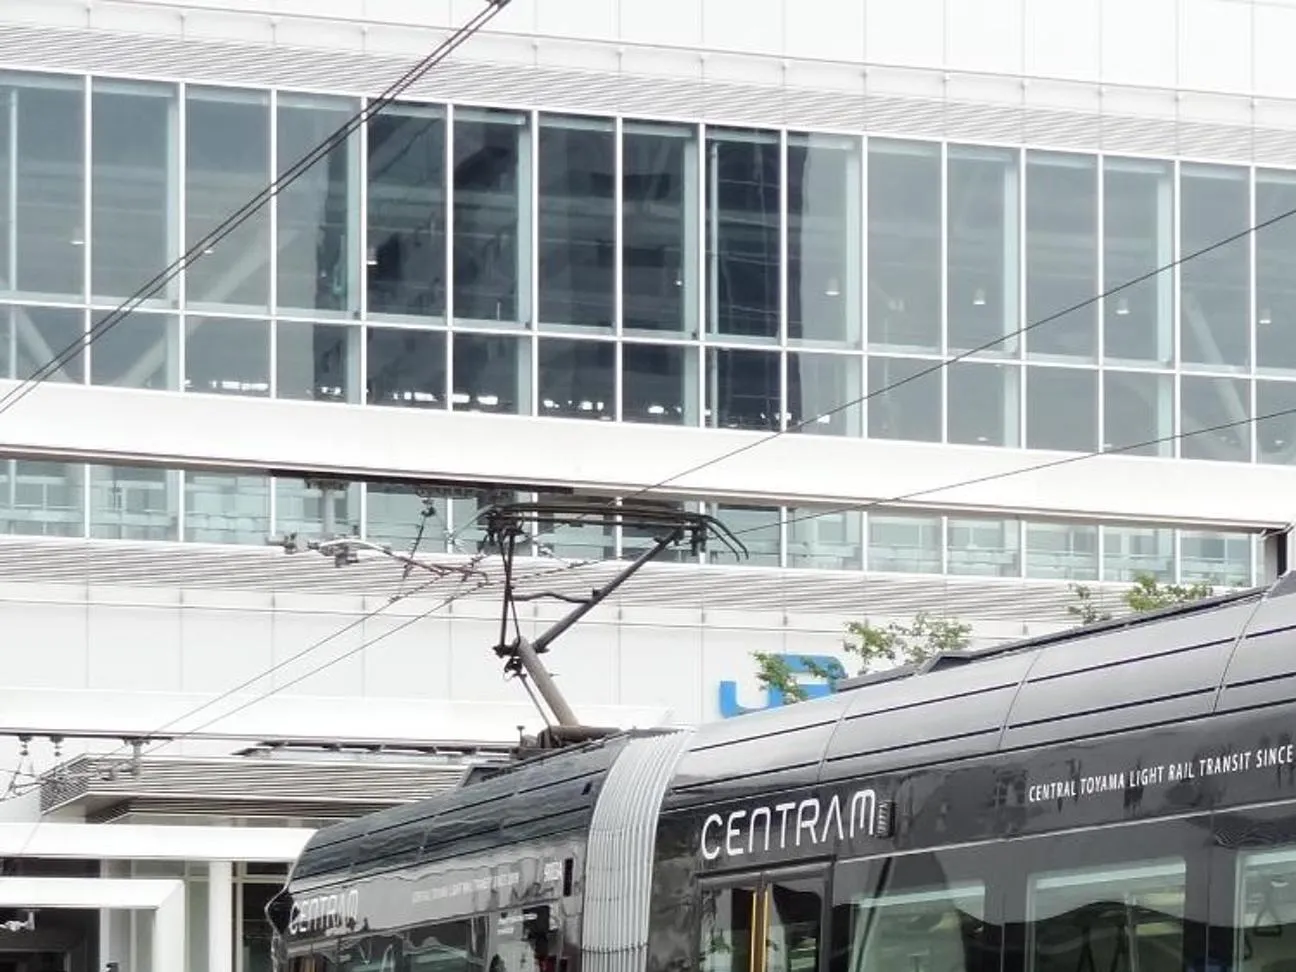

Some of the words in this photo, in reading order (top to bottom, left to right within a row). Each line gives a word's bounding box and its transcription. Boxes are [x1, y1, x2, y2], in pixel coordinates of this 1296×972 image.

[1029, 779, 1077, 802] CENTRAL
[1080, 771, 1125, 796] TOYAMA
[1129, 765, 1165, 788] LIGHT
[1167, 762, 1195, 781] RAIL
[1199, 752, 1252, 777] TRANSIT
[1255, 744, 1294, 768] SINCE
[701, 788, 876, 860] CENTRAM
